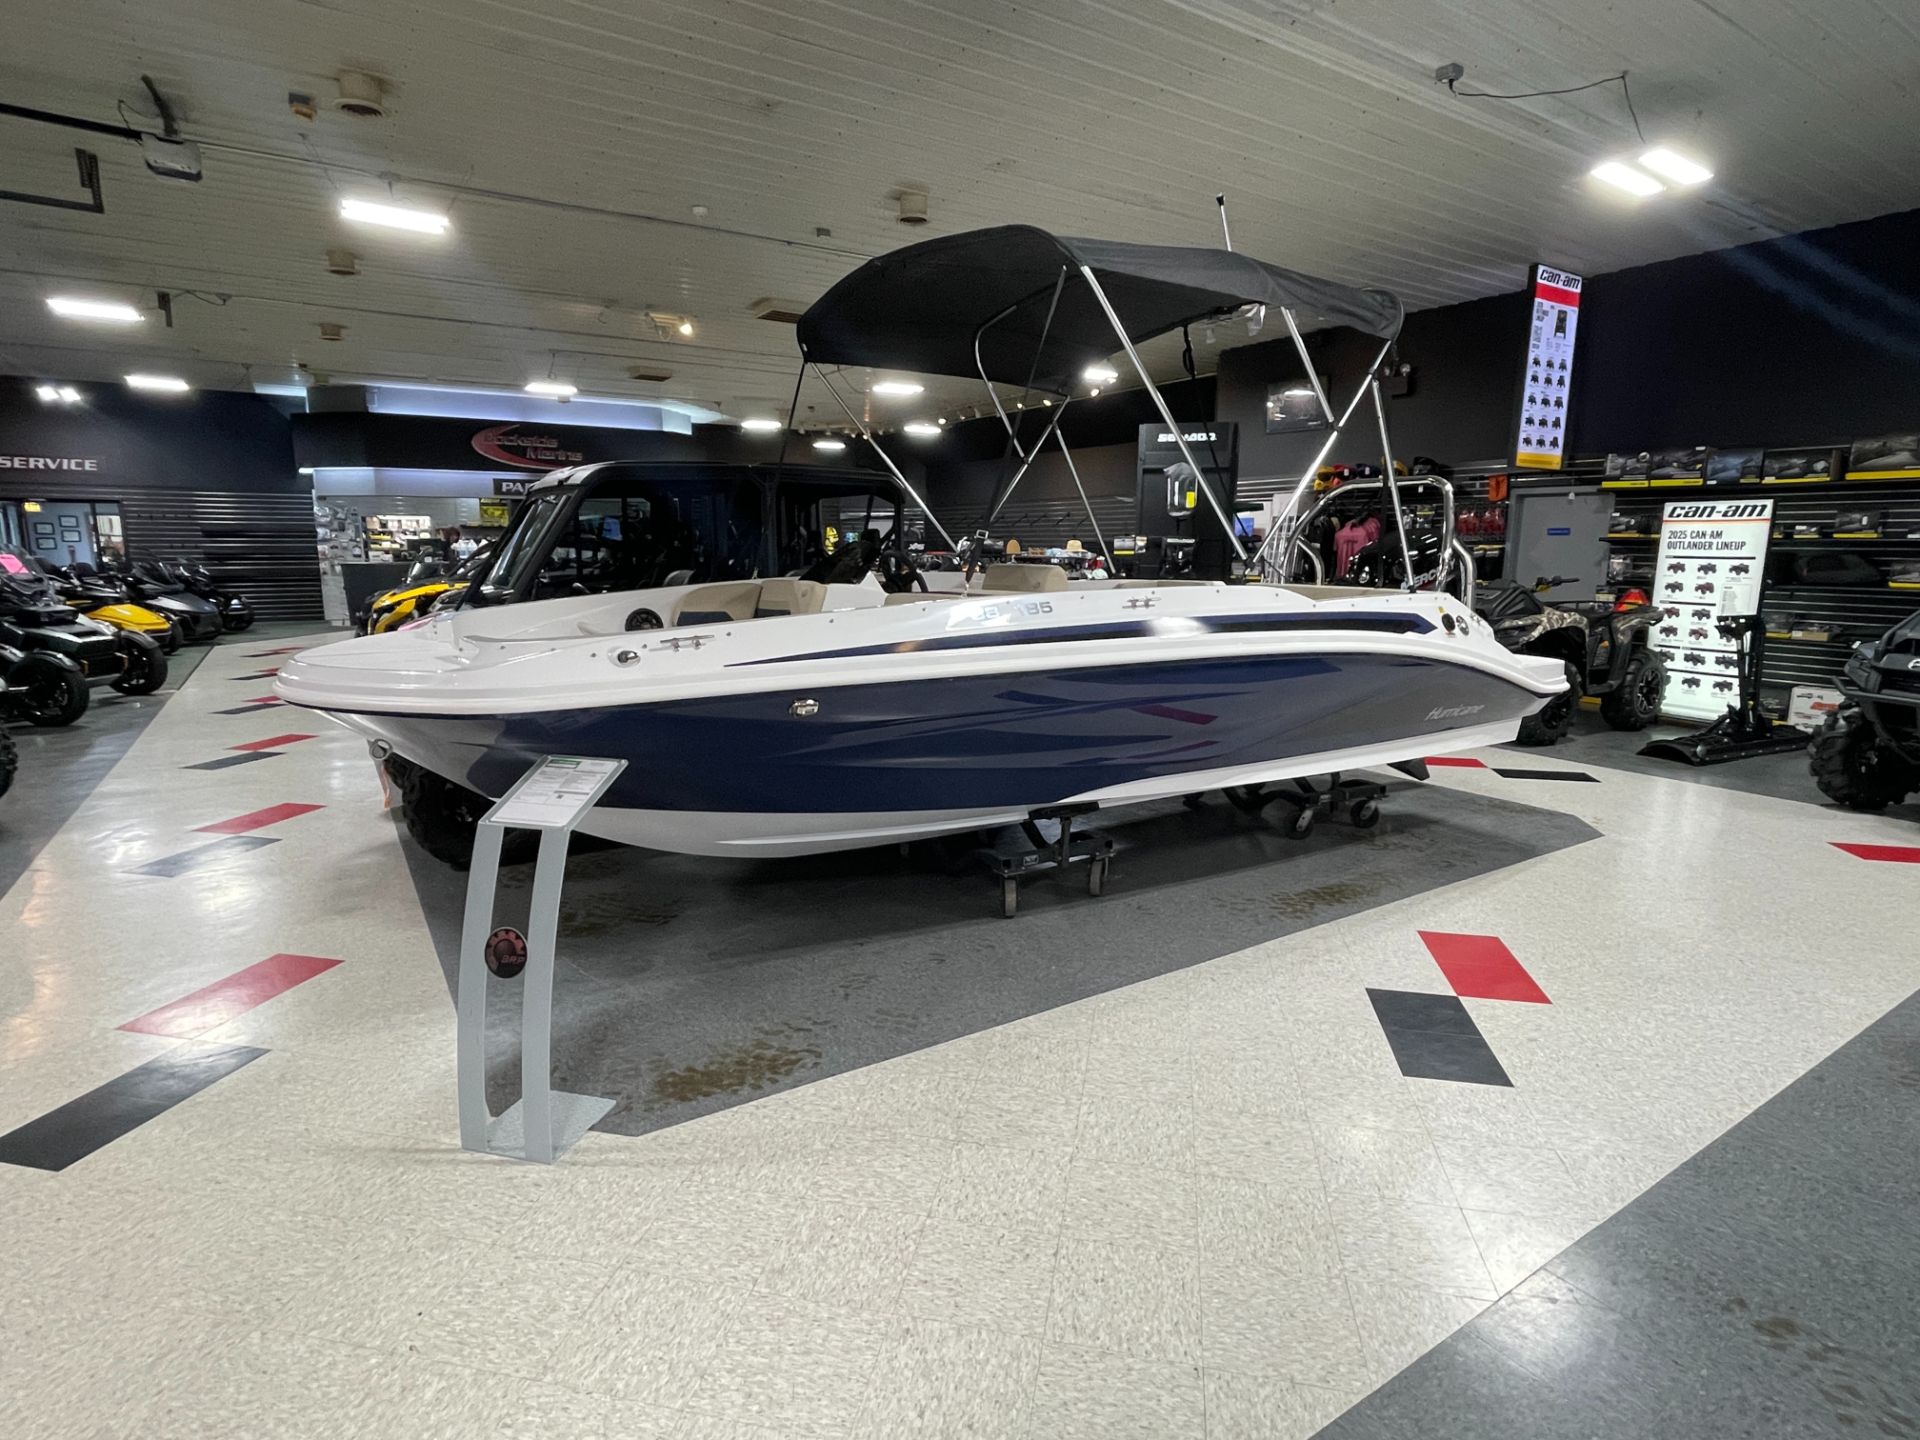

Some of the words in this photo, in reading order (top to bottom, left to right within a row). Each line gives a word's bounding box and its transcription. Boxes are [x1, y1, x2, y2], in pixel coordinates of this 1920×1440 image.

[1540, 269, 1580, 290] can-am
[0, 456, 98, 471] SERVICE
[1668, 504, 1768, 518] can-am
[1668, 530, 1687, 540] 2025
[1667, 541, 1713, 550] OUTLANDER
[1716, 541, 1746, 551] LINEUP
